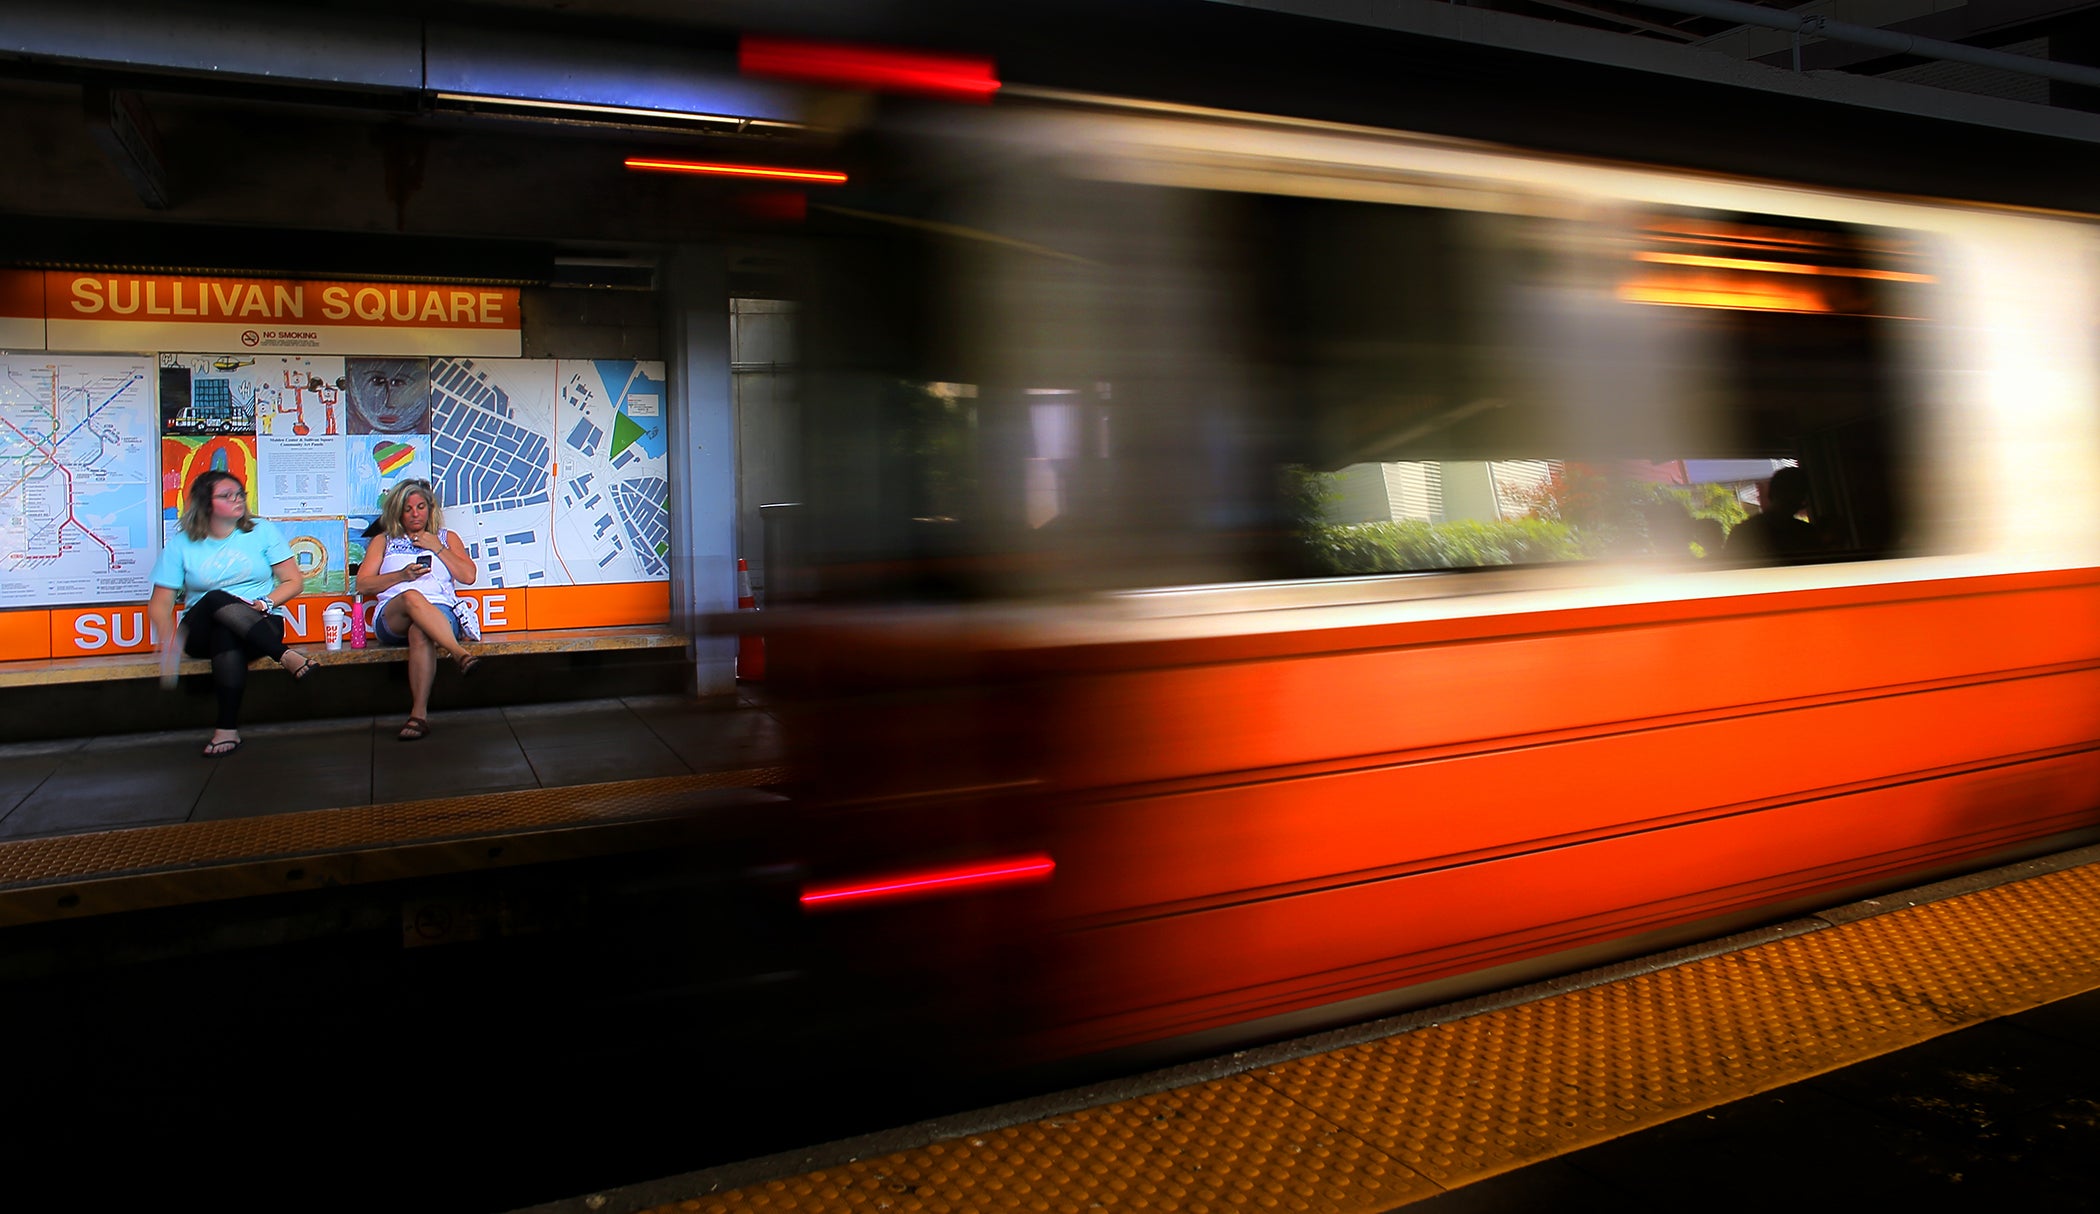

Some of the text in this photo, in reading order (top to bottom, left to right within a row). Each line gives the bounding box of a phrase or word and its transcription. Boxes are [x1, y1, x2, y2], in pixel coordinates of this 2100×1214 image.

[71, 277, 504, 323] SULLIVAN SQUARE
[279, 331, 317, 339] SMOKING
